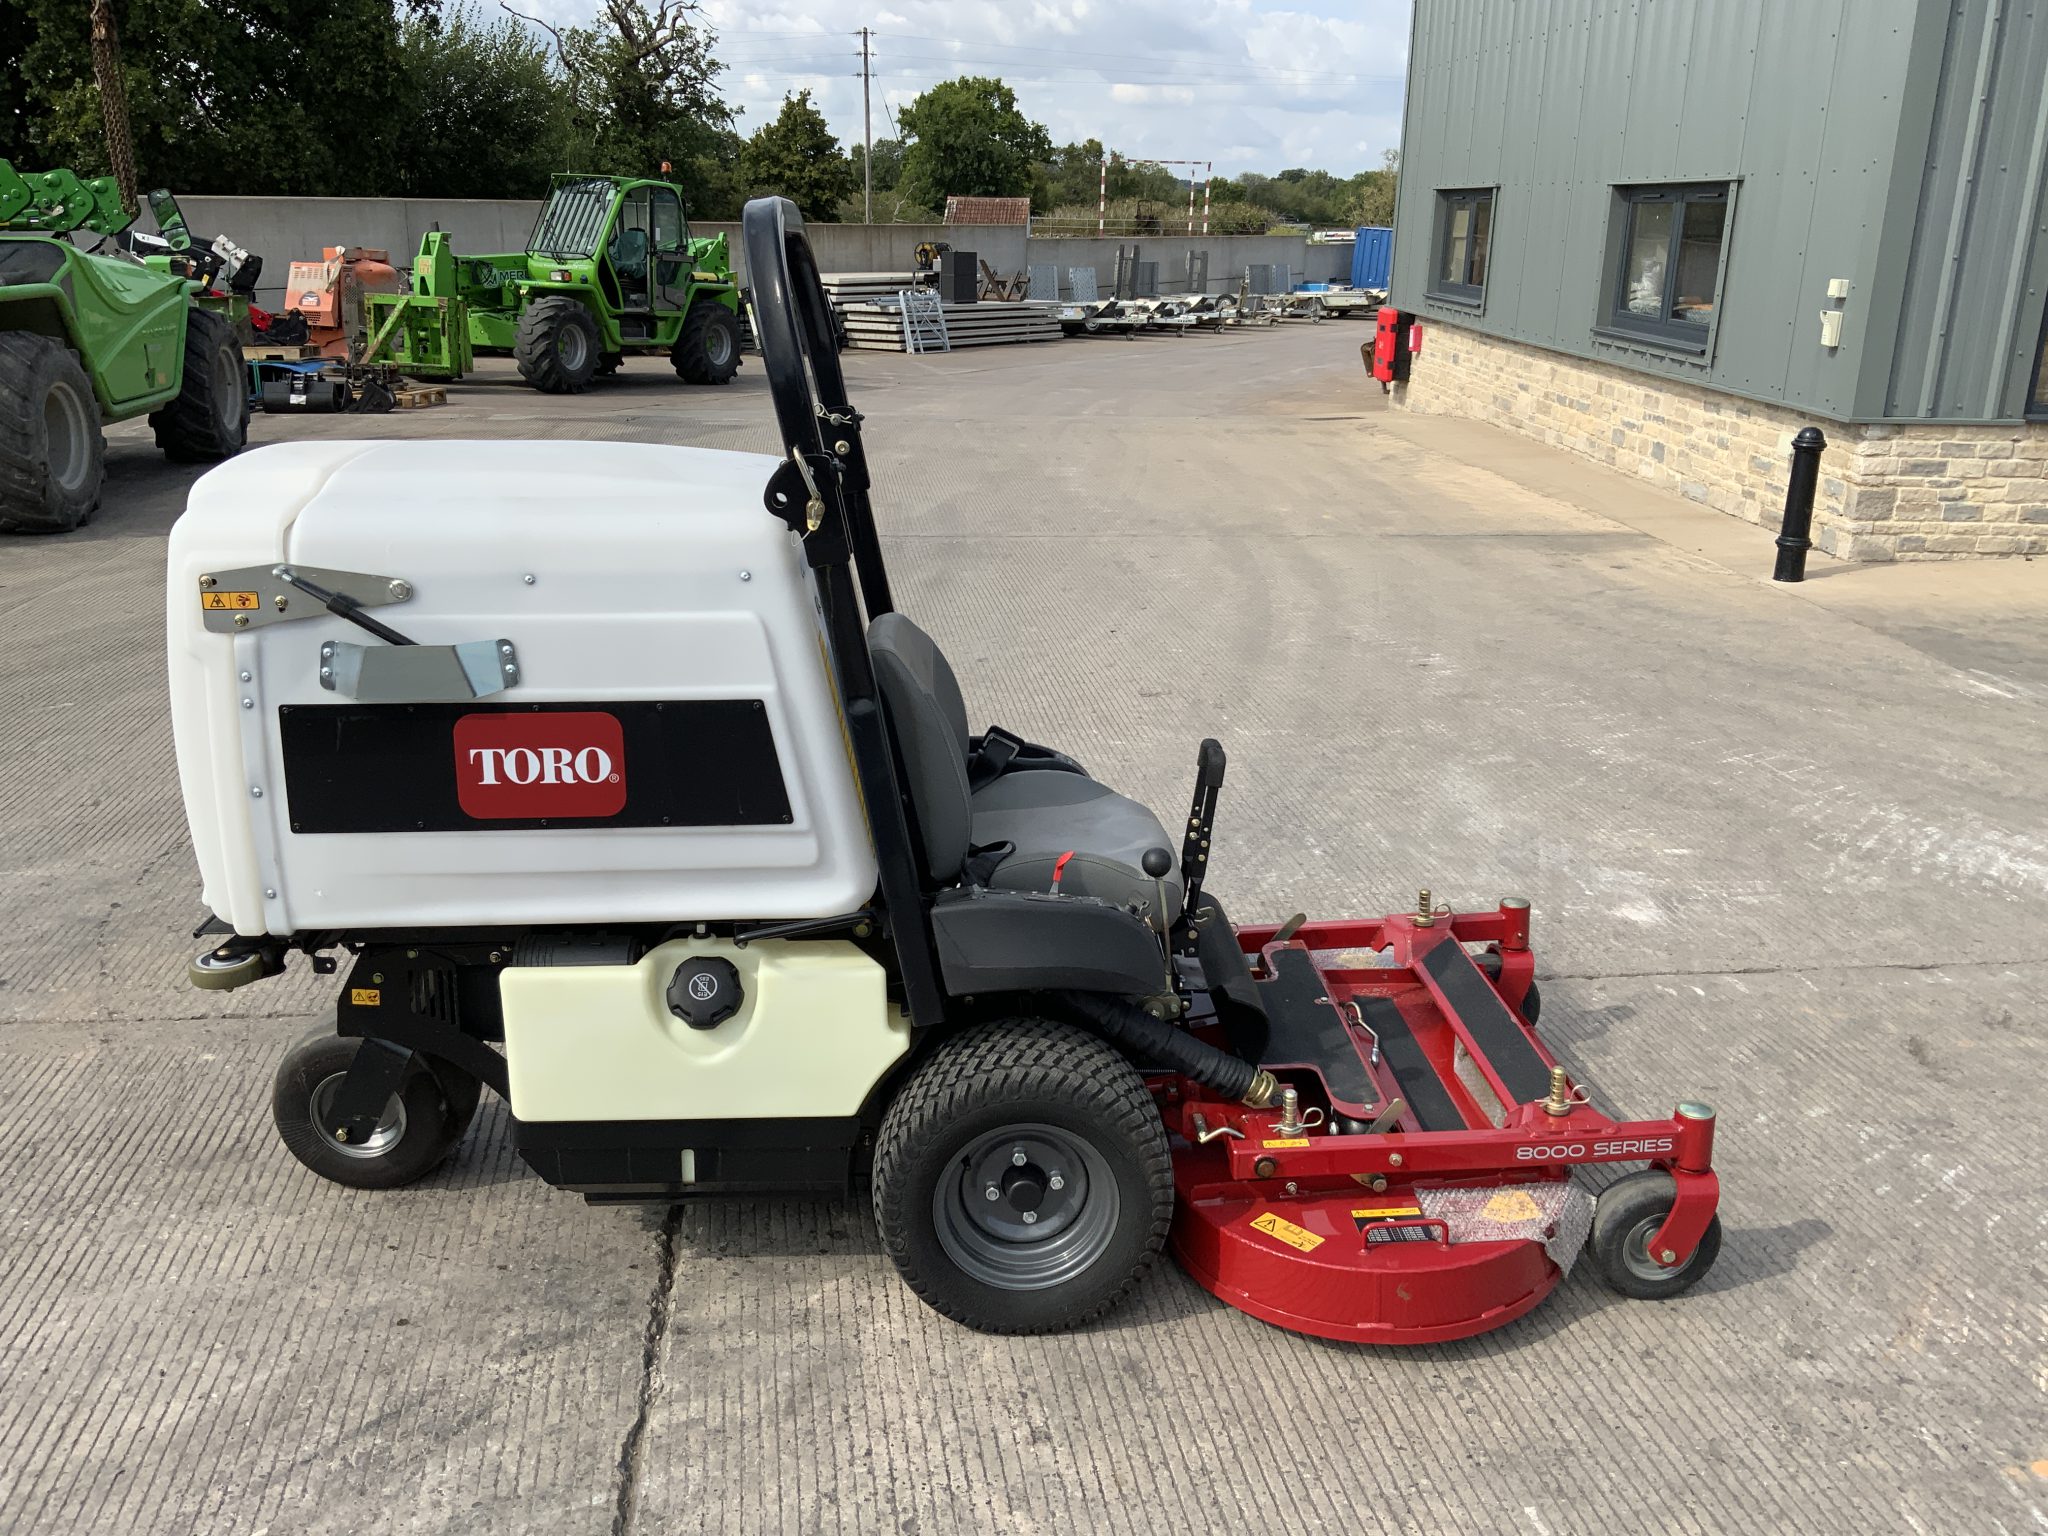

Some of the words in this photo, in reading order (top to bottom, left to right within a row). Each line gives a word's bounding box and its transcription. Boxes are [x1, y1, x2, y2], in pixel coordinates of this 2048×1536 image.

[469, 747, 612, 785] TORO
[1516, 1144, 1585, 1160] 8000
[1593, 1138, 1673, 1156] SERIES
